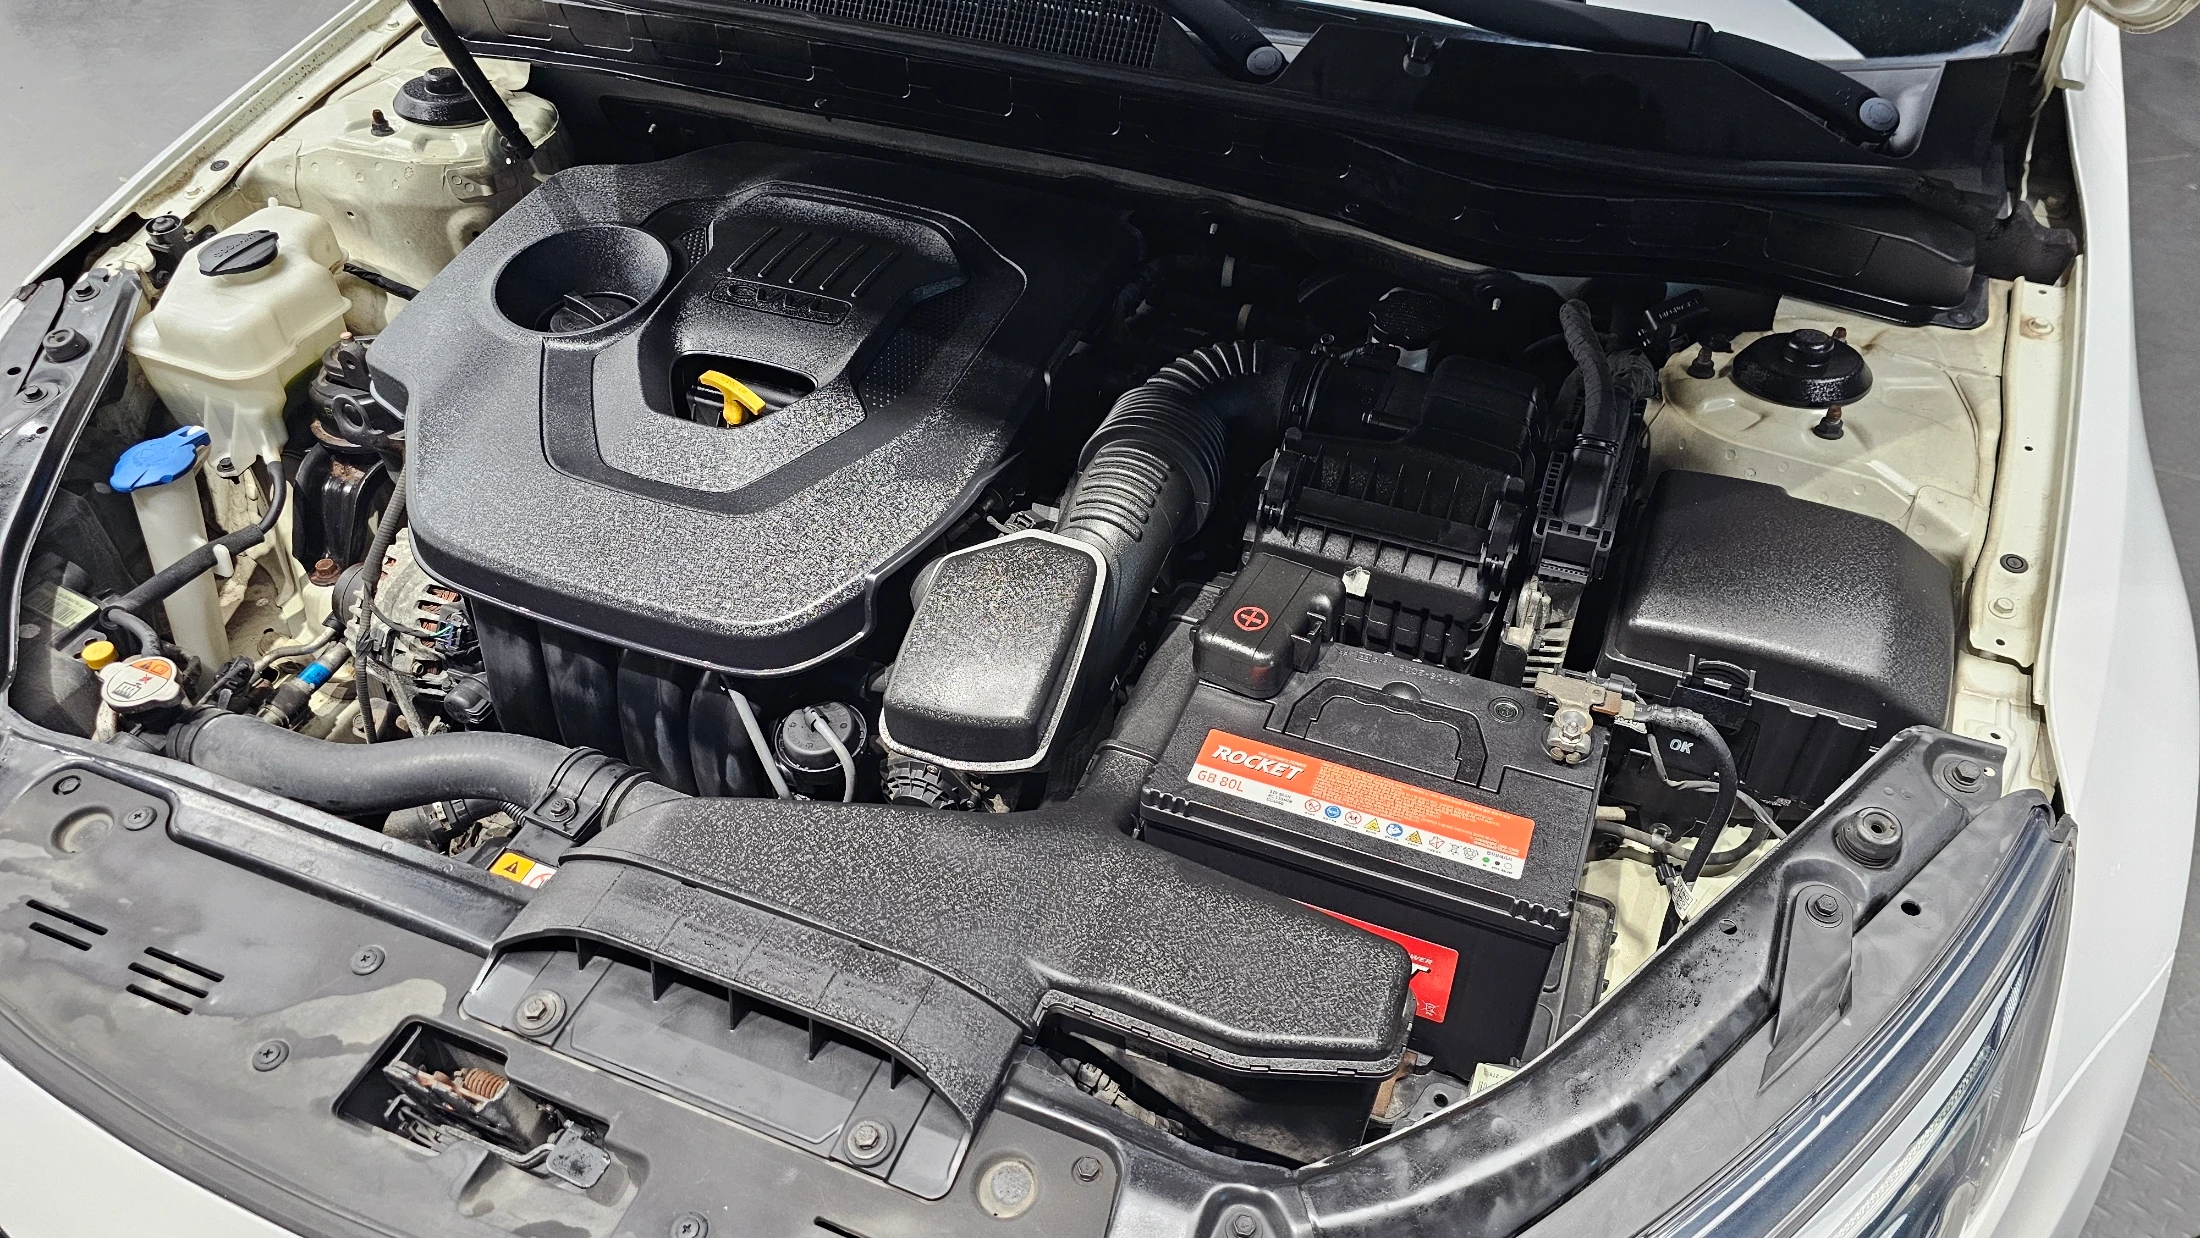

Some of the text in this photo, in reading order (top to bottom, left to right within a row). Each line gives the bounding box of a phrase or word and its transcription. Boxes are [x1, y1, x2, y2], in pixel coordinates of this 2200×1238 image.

[1669, 738, 1694, 754] OK
[1211, 744, 1305, 781] ROCKET
[1197, 770, 1244, 792] GB 80L
[1407, 953, 1433, 965] WER
